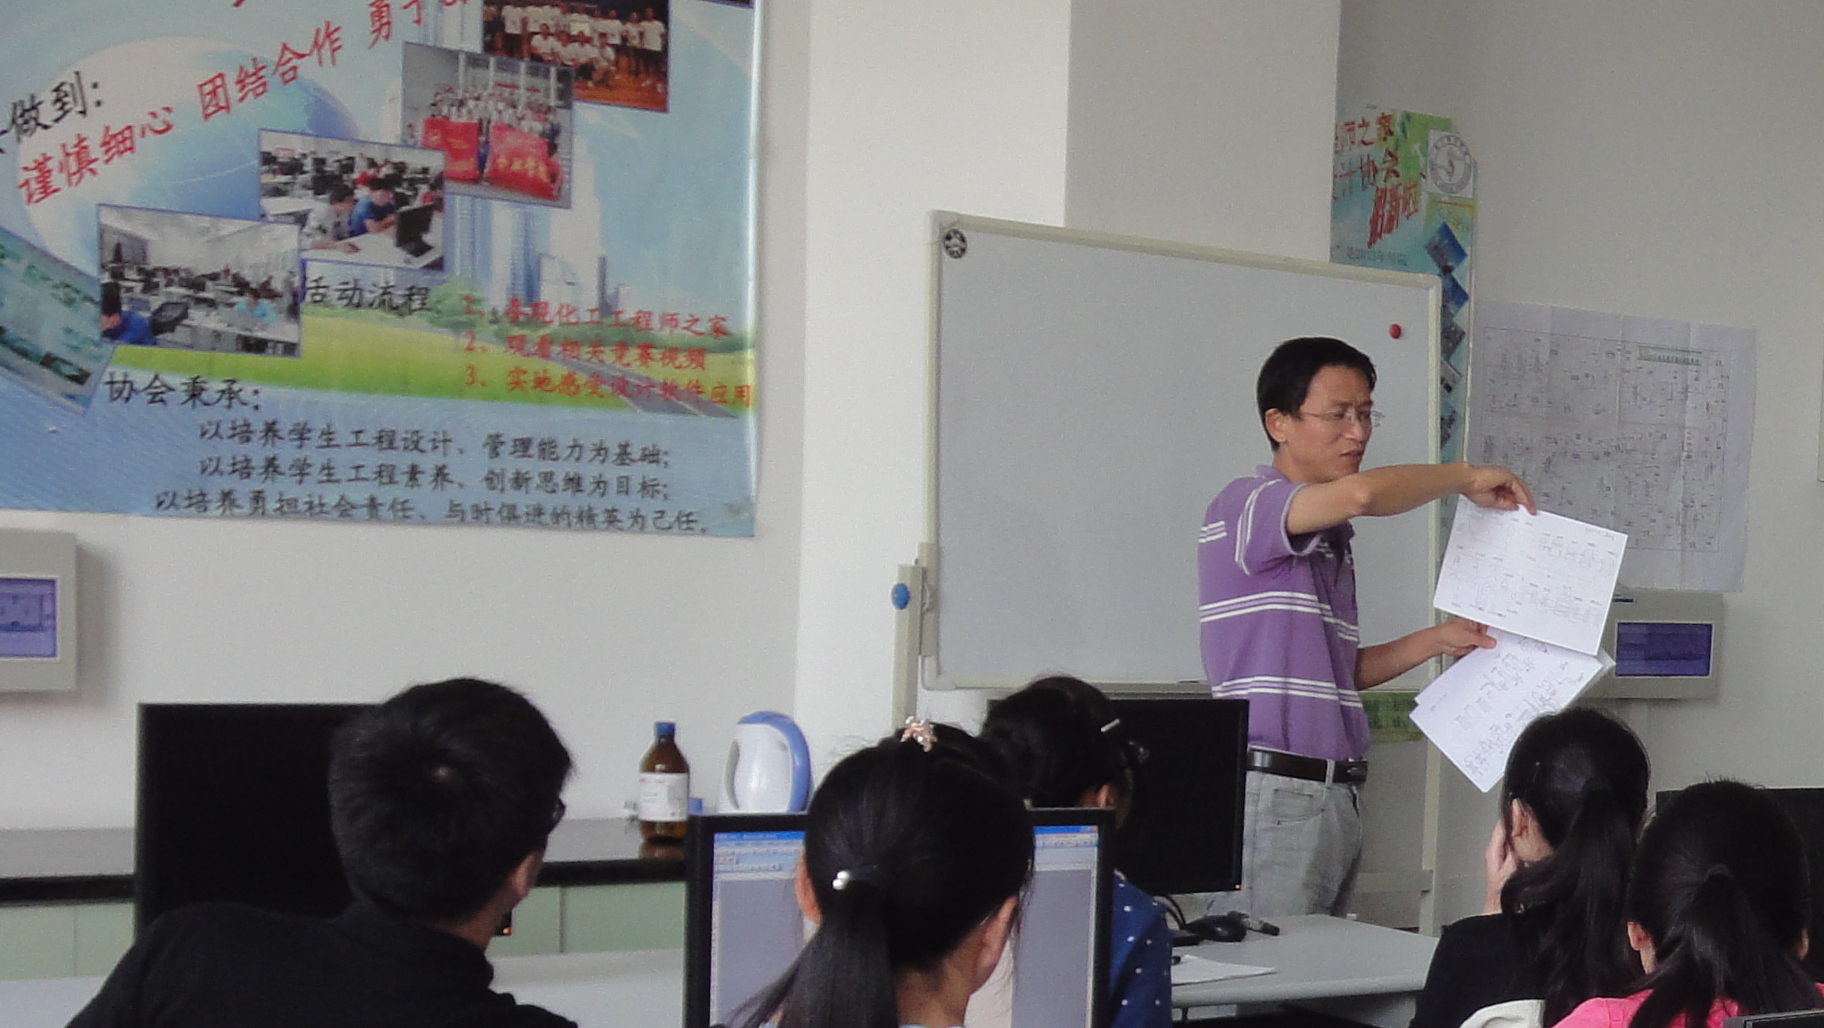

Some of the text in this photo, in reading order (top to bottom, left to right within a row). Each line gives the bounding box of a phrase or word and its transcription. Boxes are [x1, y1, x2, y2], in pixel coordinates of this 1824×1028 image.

[0, 70, 102, 154] 做到：
[16, 105, 174, 205] 谨慎细心
[197, 20, 343, 121] 团结合作
[104, 371, 260, 412] 协会秉承：
